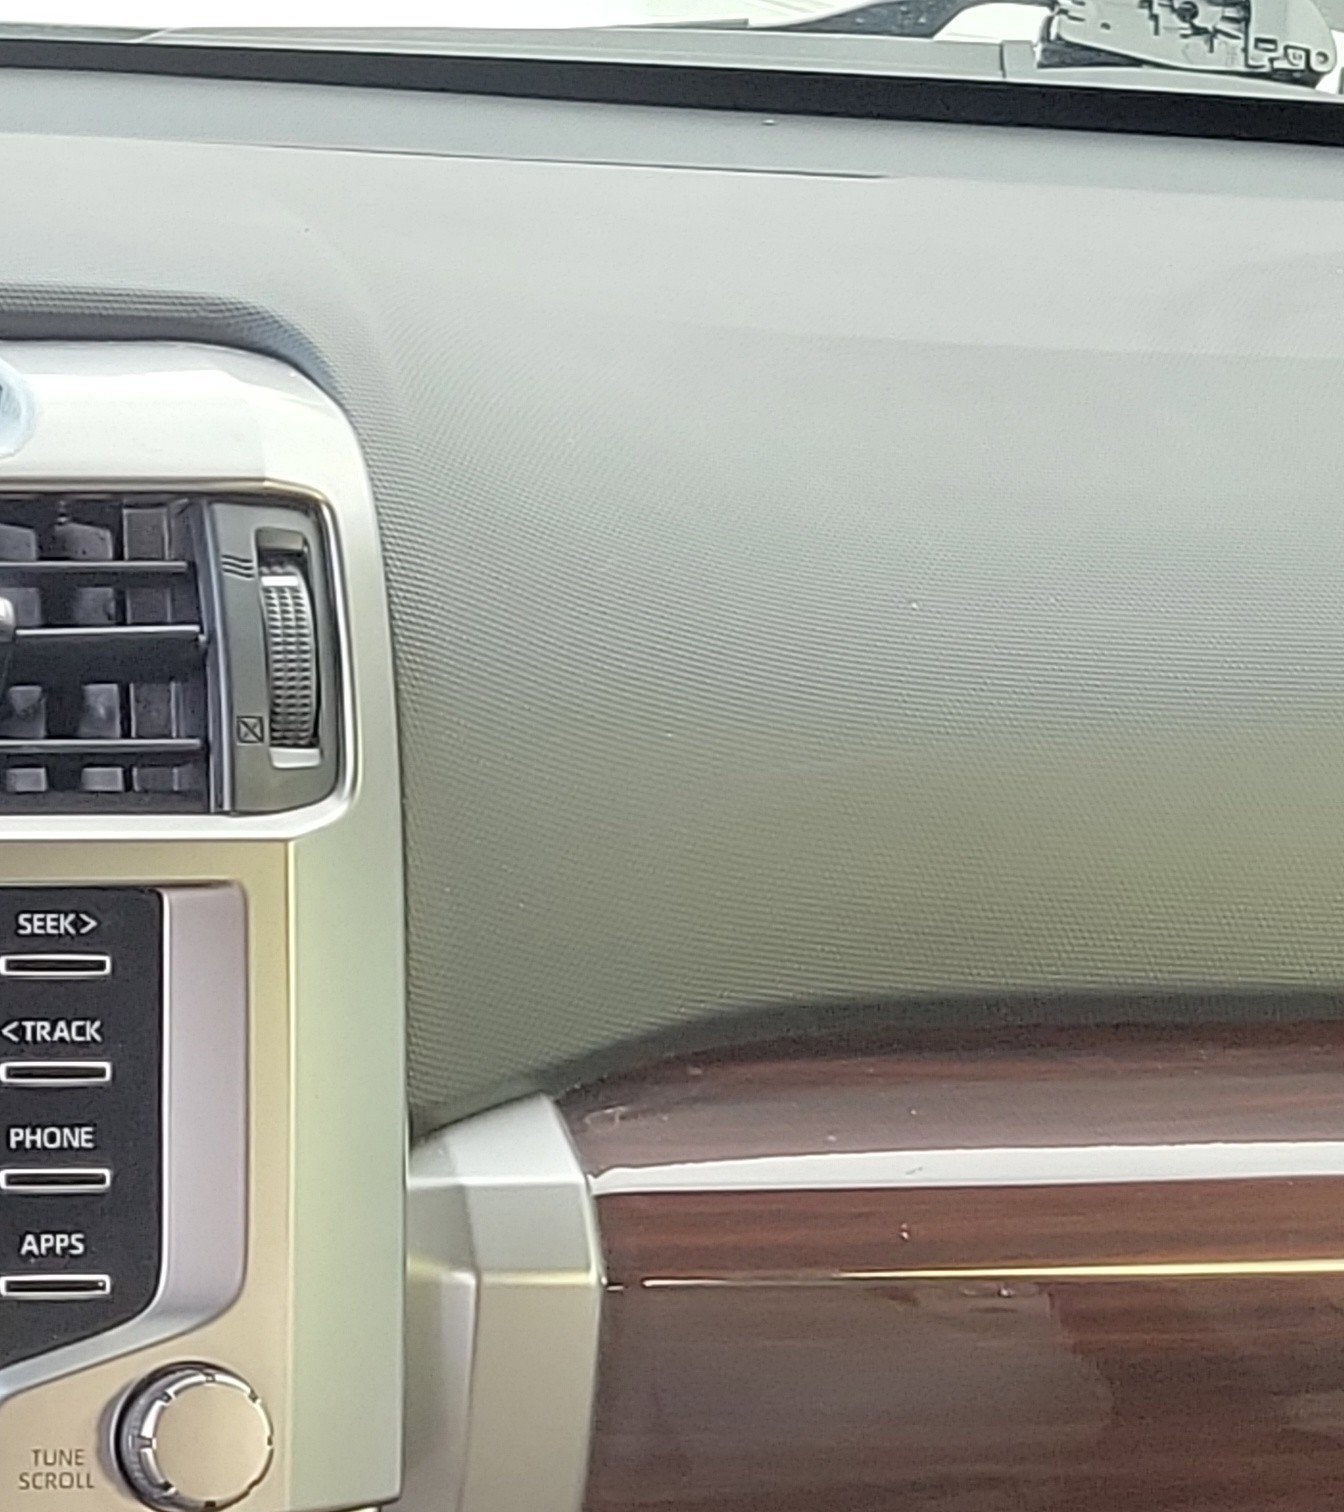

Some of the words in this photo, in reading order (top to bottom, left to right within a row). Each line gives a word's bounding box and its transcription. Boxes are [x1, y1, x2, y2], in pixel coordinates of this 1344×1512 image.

[9, 1126, 94, 1149] PHONE
[20, 1233, 85, 1256] APPS
[31, 1448, 85, 1467] TUNE
[18, 1471, 96, 1491] SCROLL
